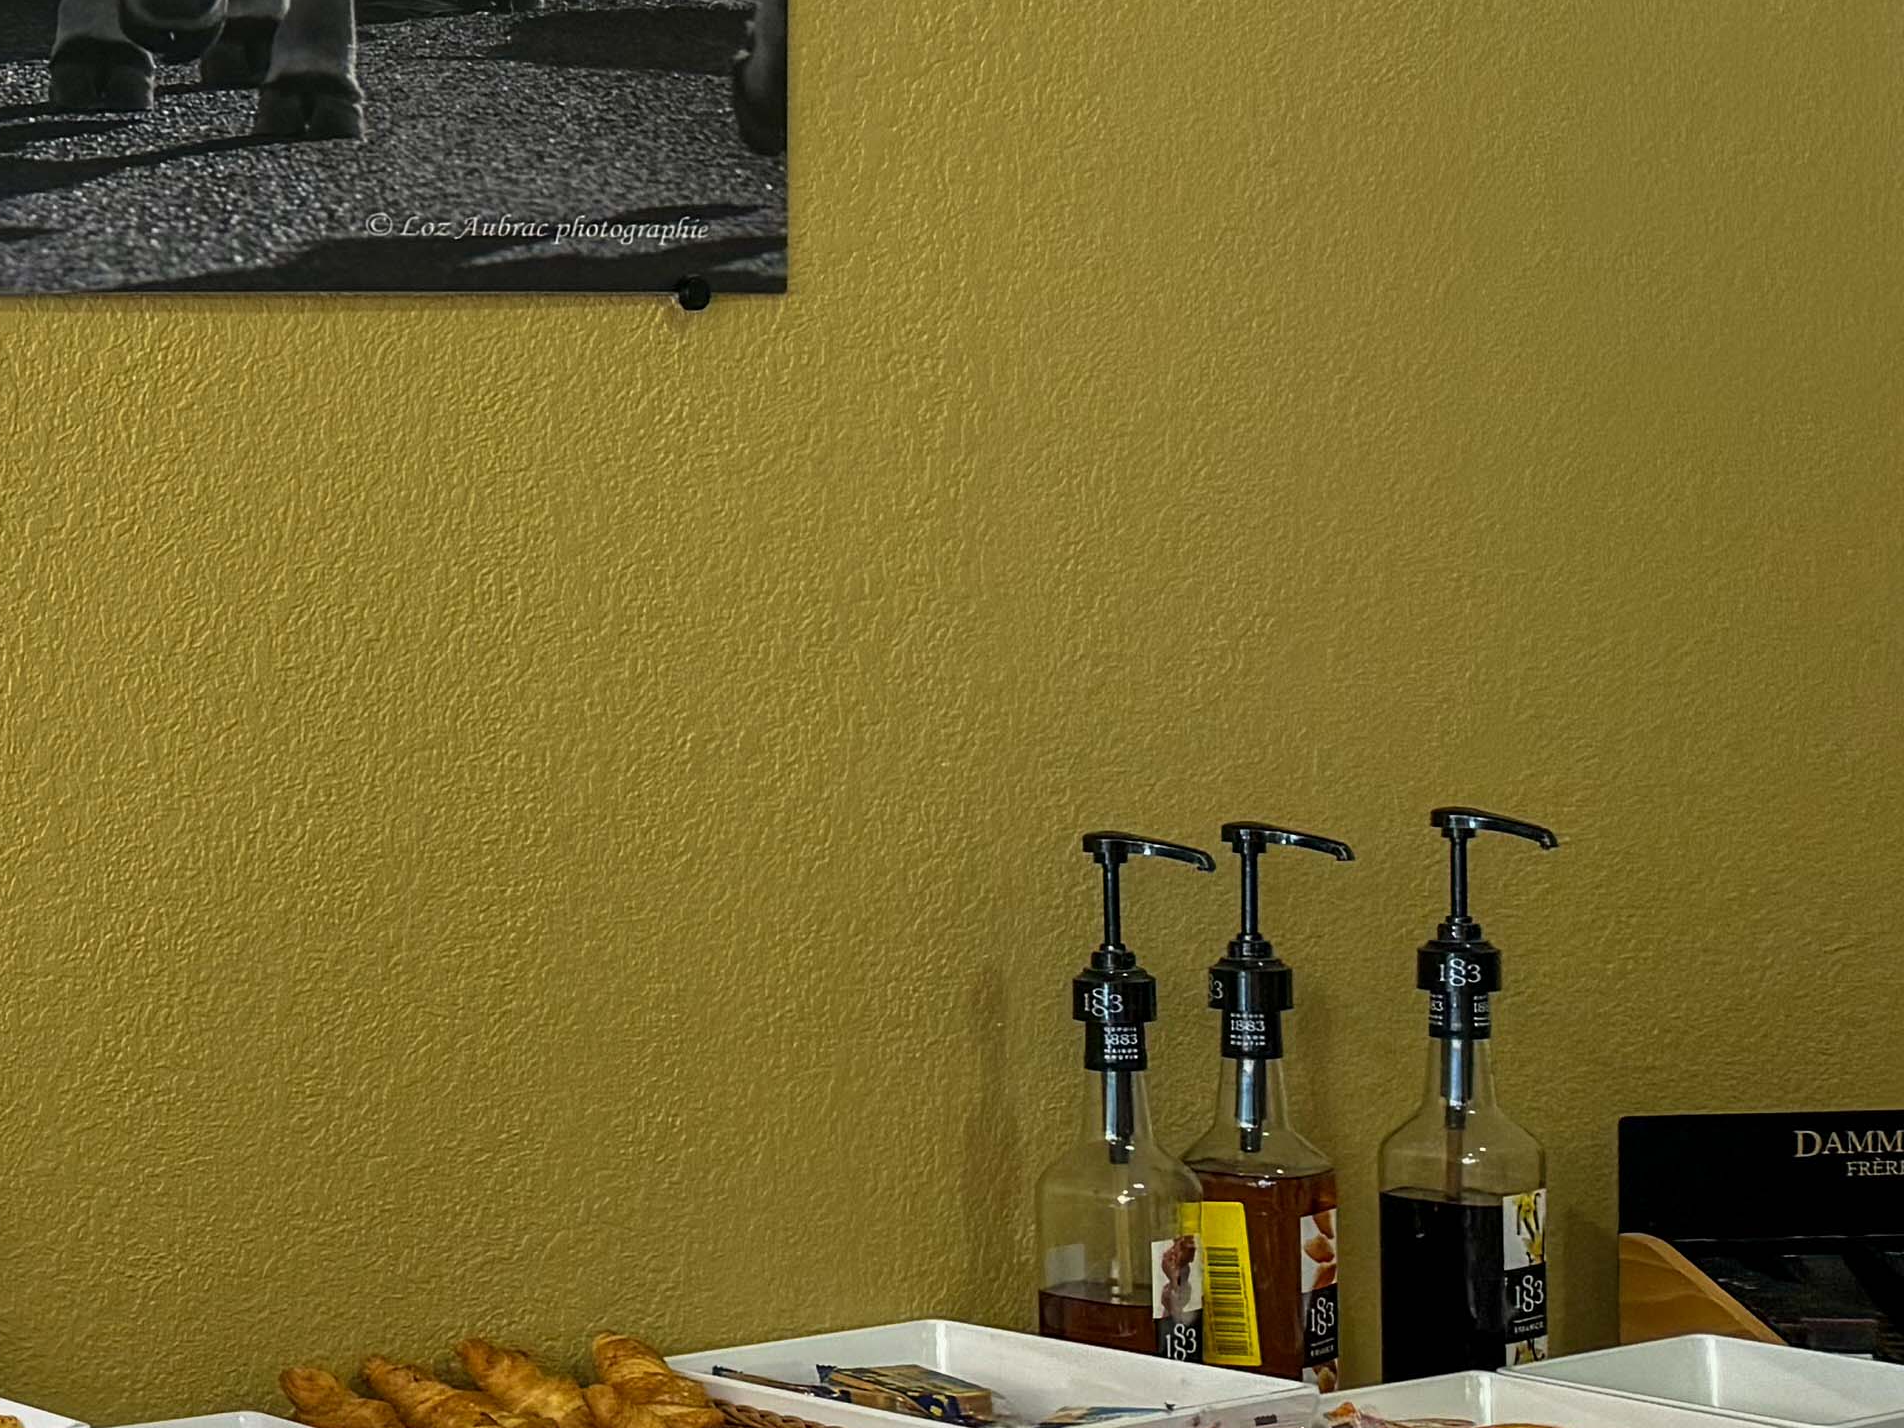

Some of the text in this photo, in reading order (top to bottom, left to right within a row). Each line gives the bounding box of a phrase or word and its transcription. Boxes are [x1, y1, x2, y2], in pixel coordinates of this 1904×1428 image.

[399, 215, 452, 237] Loz
[453, 213, 549, 240] Aubrac
[552, 214, 710, 246] photographie
[1104, 1033, 1138, 1045] 1883
[1515, 1274, 1544, 1313] 1883
[1311, 1297, 1335, 1336] 1883
